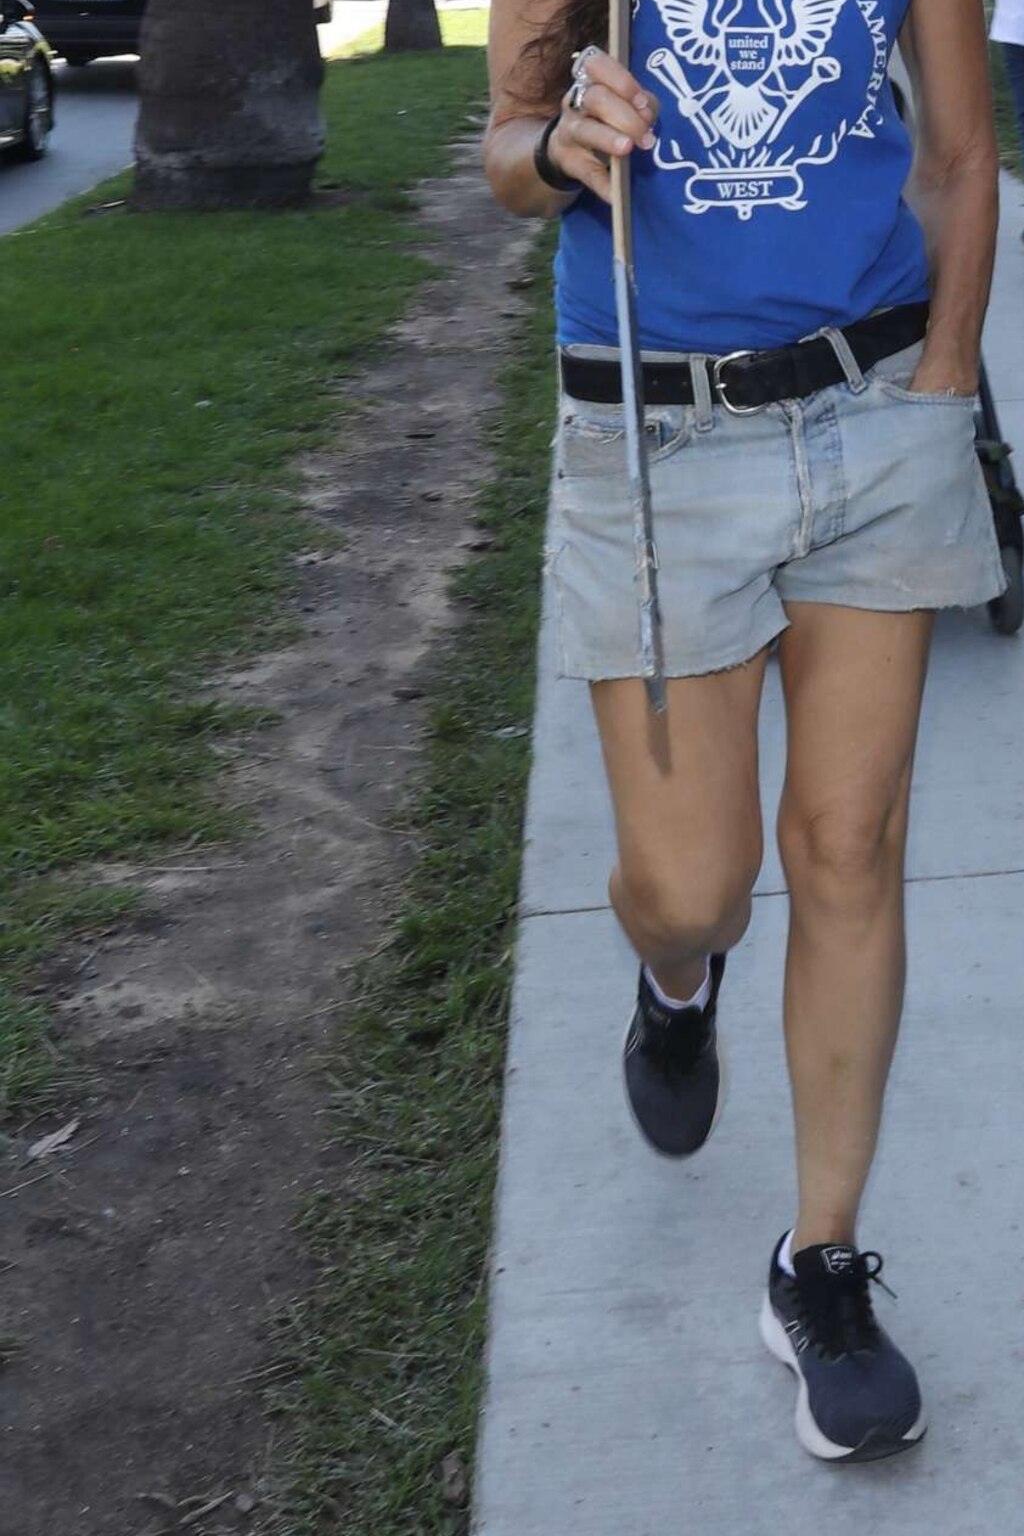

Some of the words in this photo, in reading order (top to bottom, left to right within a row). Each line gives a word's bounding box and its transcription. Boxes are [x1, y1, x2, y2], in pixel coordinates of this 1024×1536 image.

[728, 35, 769, 48] united
[739, 50, 758, 60] we
[730, 58, 766, 71] stand
[716, 180, 774, 199] WEST
